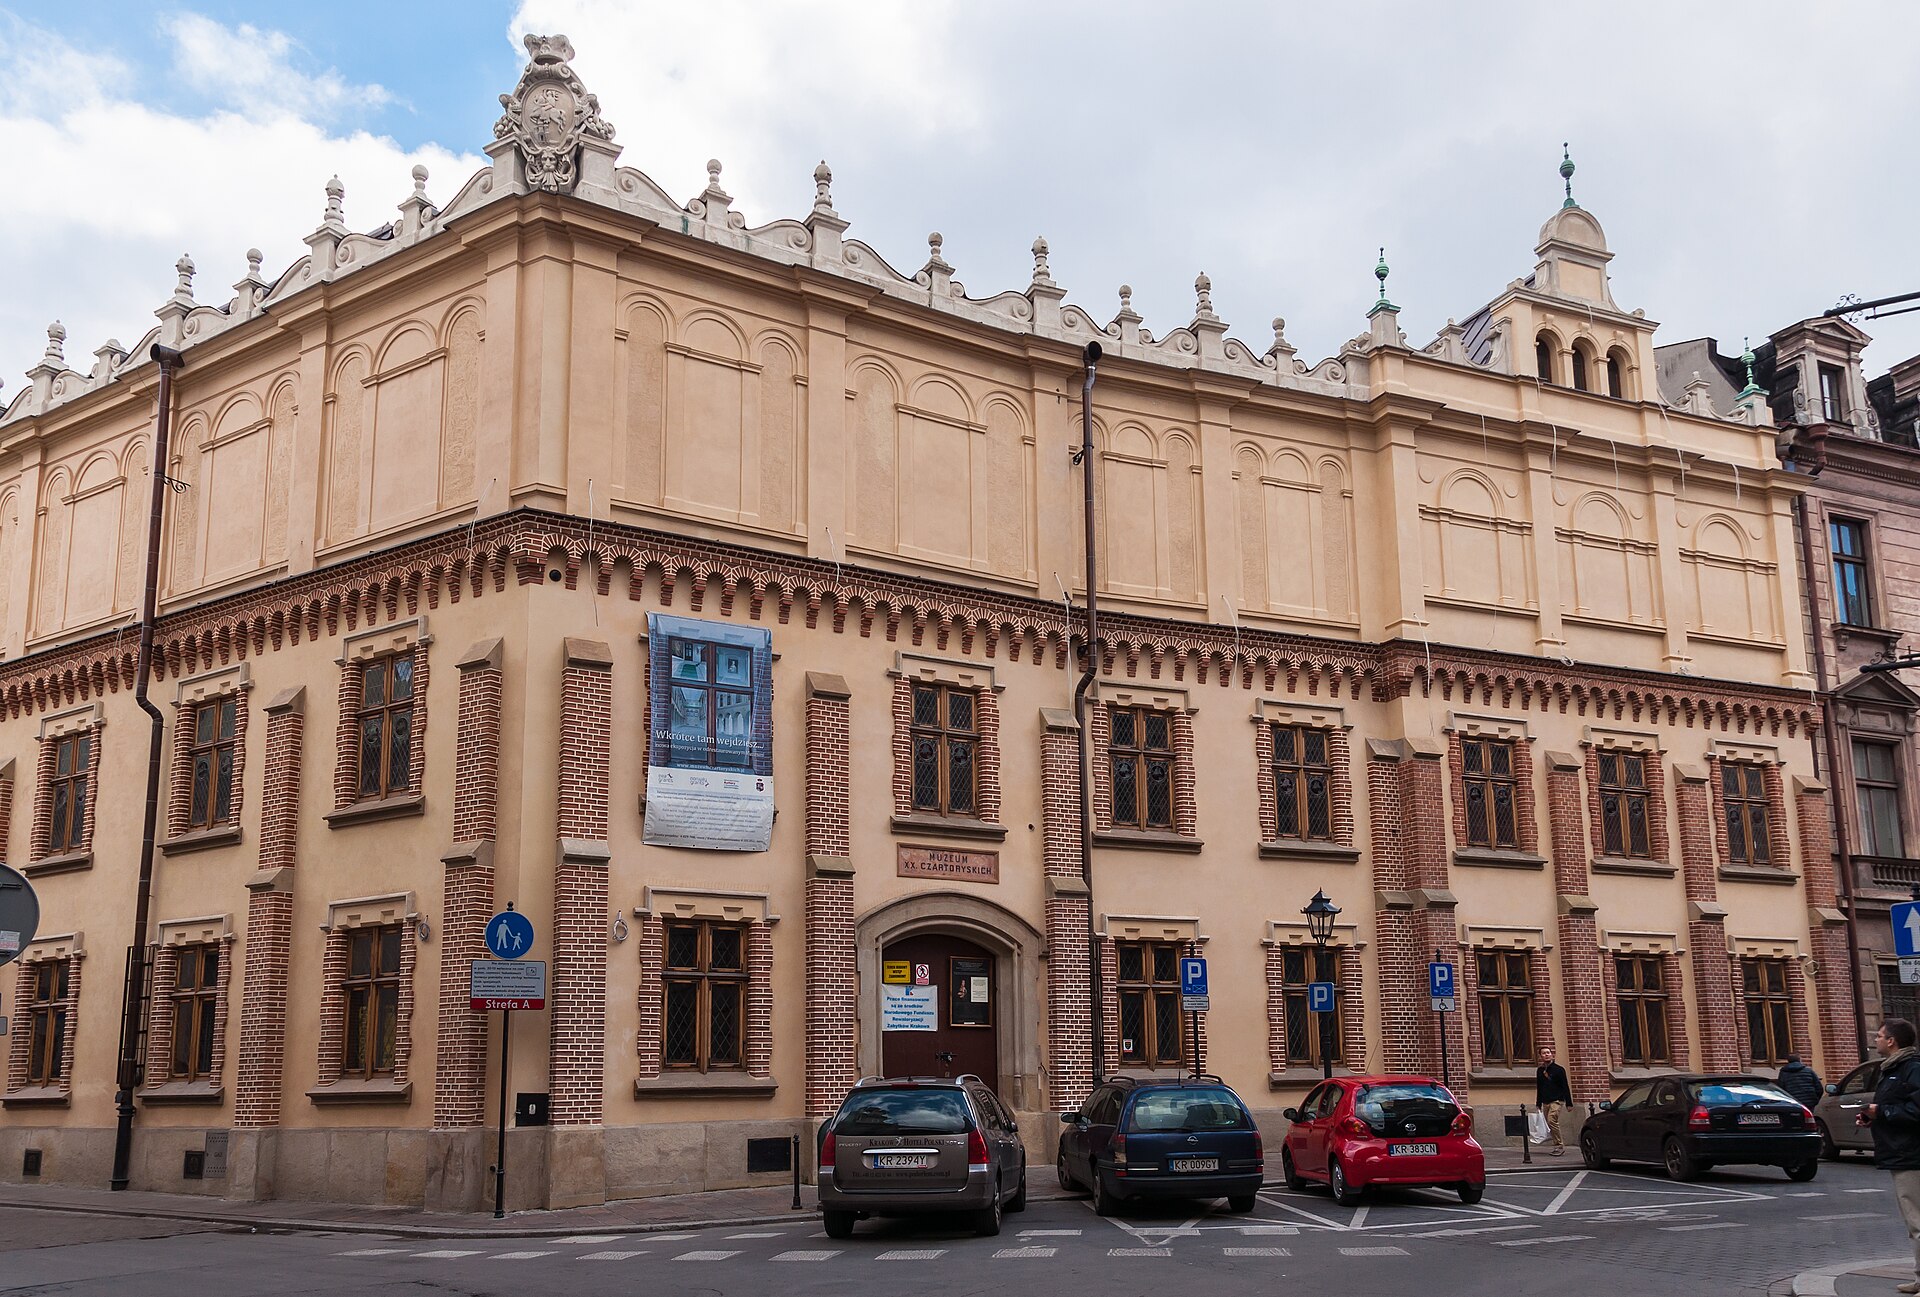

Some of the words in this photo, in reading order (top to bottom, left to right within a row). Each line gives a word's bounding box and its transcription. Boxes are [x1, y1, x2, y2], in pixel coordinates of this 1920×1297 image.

[655, 729, 695, 742] Wkrótce
[697, 734, 715, 744] tam
[929, 852, 968, 864] MUZEUM
[904, 861, 918, 870] XX.
[920, 862, 992, 875] CZARTORYSKICH
[1187, 961, 1202, 985] P
[1434, 966, 1448, 987] P
[1313, 986, 1328, 1009] P
[485, 999, 518, 1009] Strefa
[522, 999, 530, 1009] A
[903, 1138, 923, 1147] HOTEL
[924, 1137, 944, 1146] POLSKI
[1395, 1144, 1407, 1154] KR
[1410, 1144, 1436, 1153] 383CN
[879, 1155, 893, 1165] KR
[895, 1155, 926, 1165] 2394Y
[1174, 1160, 1187, 1170] KR
[1190, 1160, 1217, 1169] 009GY
